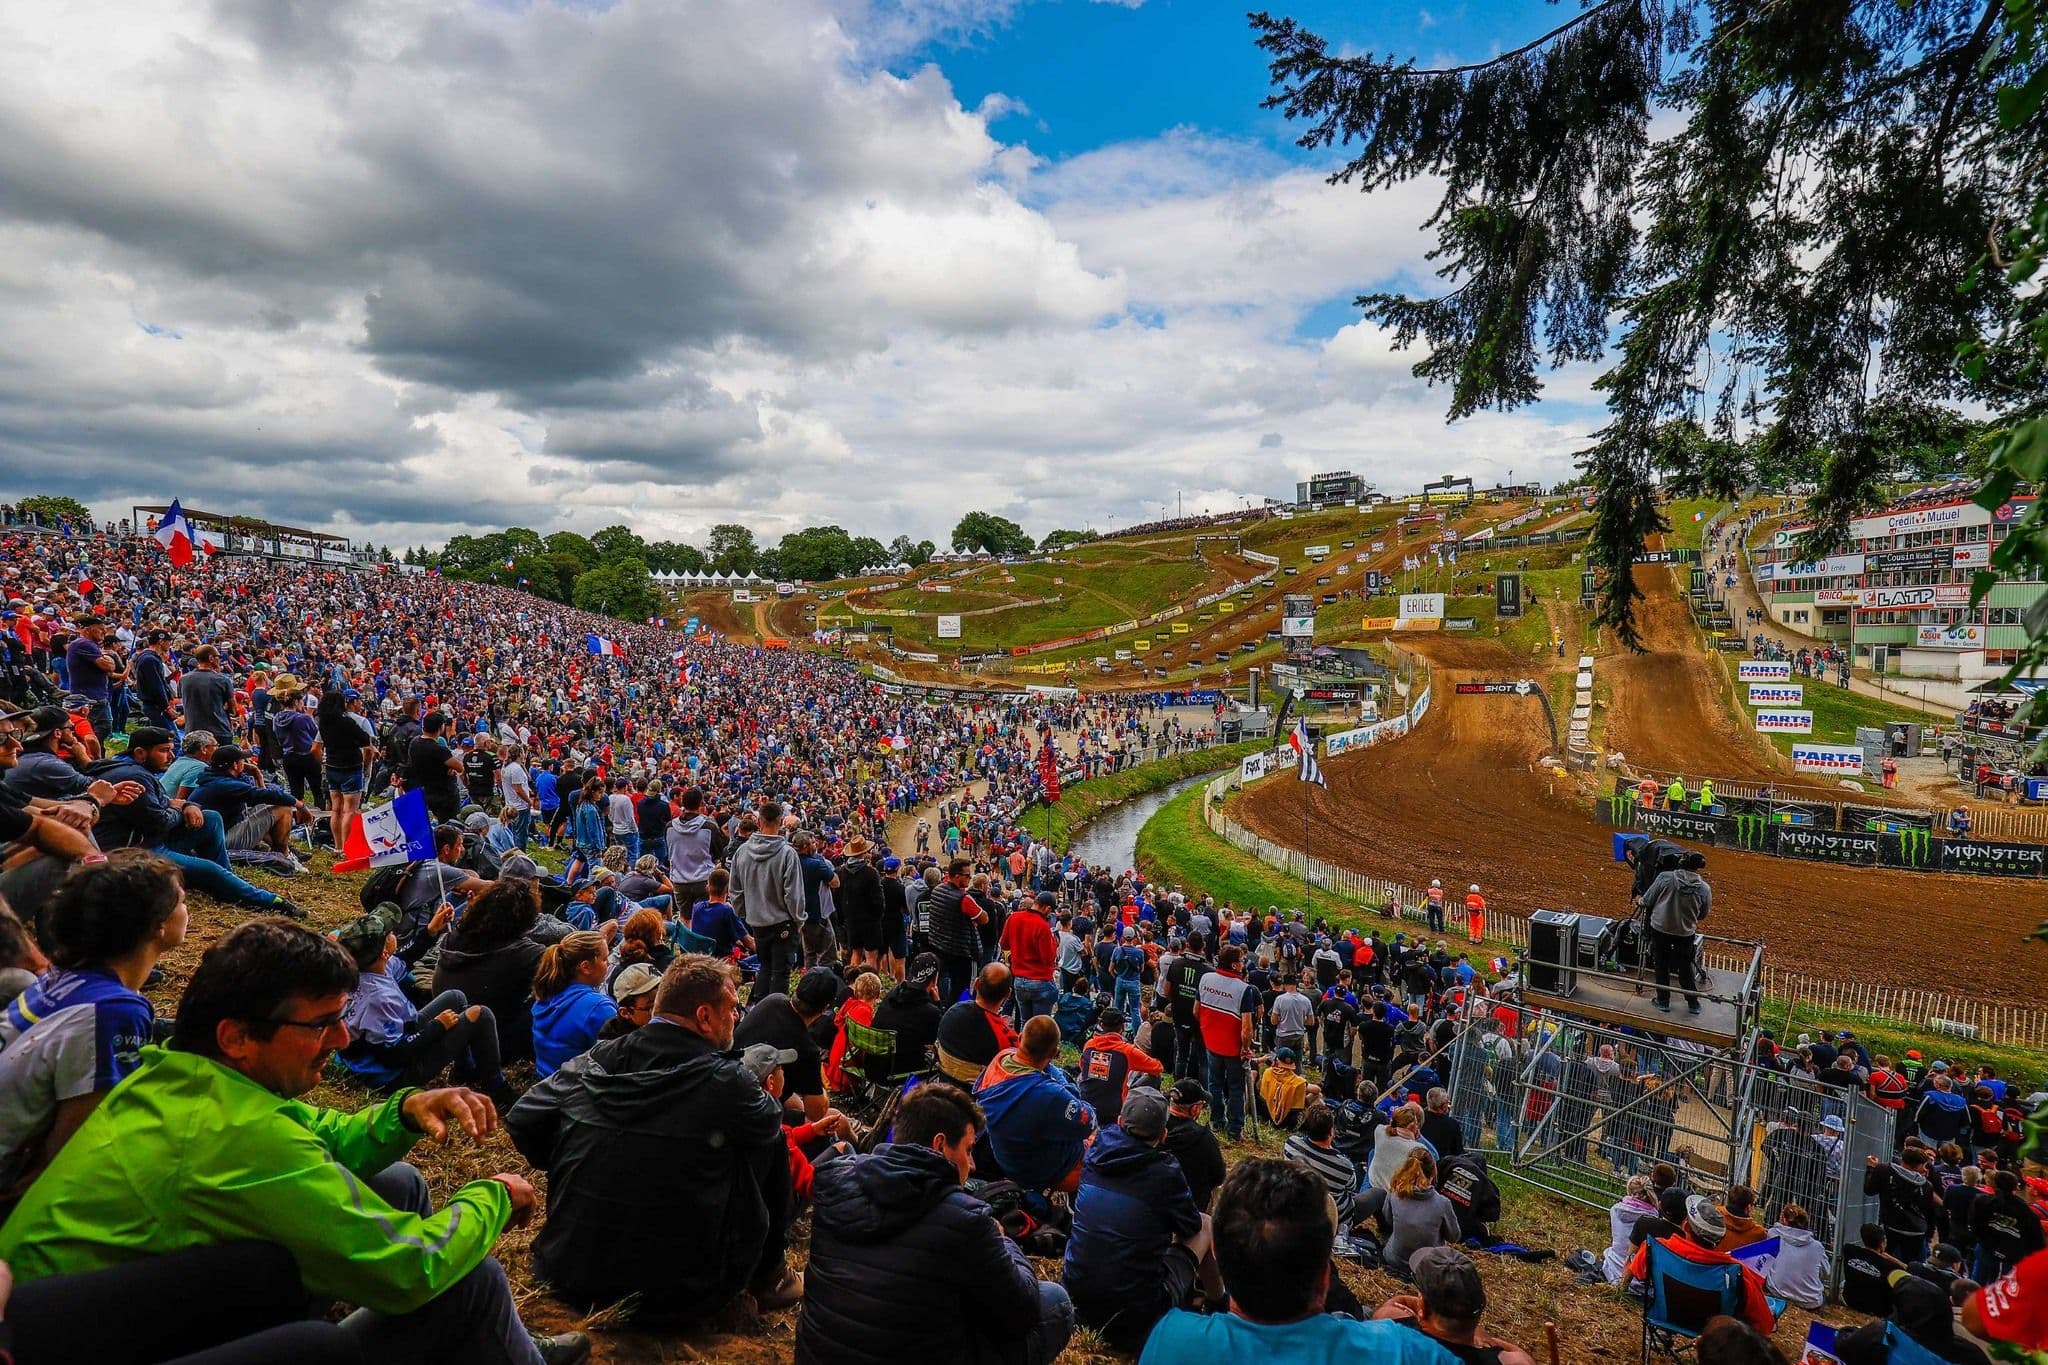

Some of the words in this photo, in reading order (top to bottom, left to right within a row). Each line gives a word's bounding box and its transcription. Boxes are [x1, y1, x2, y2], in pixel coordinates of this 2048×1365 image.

[1927, 509, 1960, 522] Mutuel
[1886, 551, 1915, 562] Cousin
[1788, 562, 1817, 575] SUPER
[1818, 590, 1843, 600] BRICO
[1878, 589, 1934, 607] LATP
[1310, 691, 1357, 699] HOLESHOT
[1750, 689, 1802, 697] PARTS
[1757, 715, 1811, 723] PARTS
[1793, 751, 1862, 762] PARTS
[1636, 811, 1717, 834] MONSTER
[1646, 826, 1704, 840] ENERGY
[1779, 831, 1877, 852] MONSTER
[1793, 846, 1862, 858] ENERGY
[1944, 844, 2042, 862] MONSTER
[1959, 859, 2028, 870] ENERGY
[1203, 985, 1233, 999] HONDA
